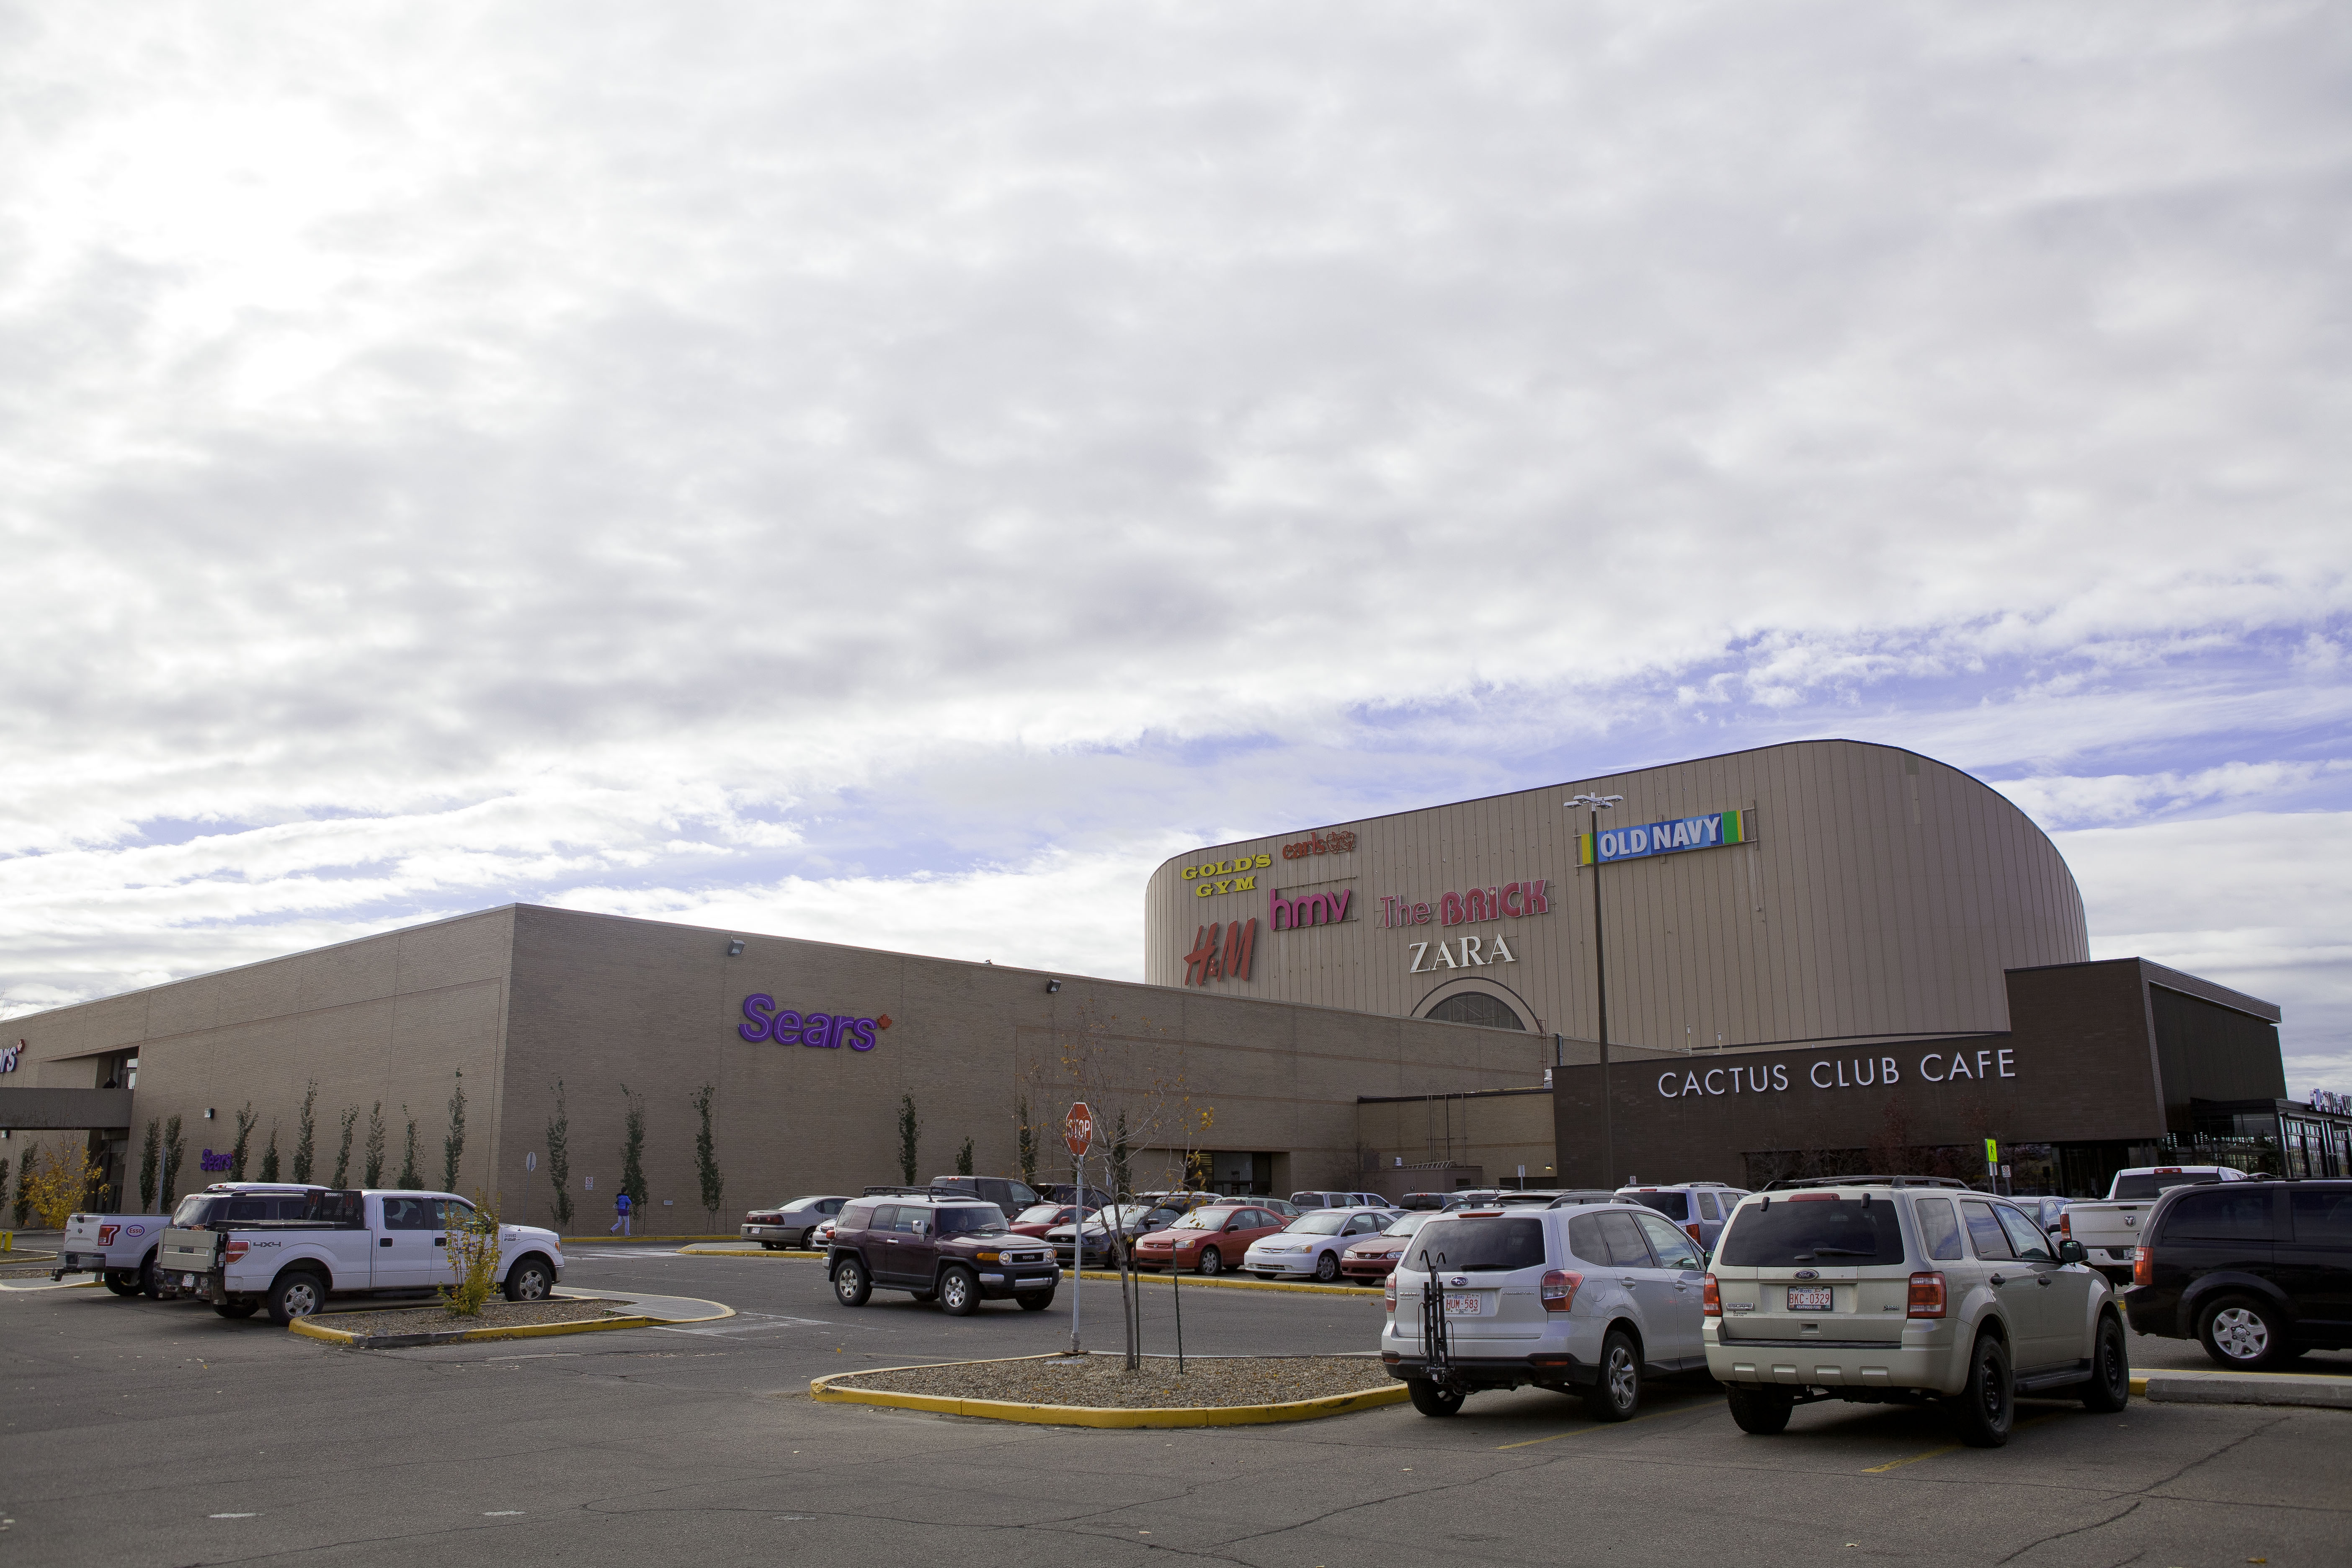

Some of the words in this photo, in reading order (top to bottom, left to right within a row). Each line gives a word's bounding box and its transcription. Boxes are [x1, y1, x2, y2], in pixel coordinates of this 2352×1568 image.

[1282, 831, 1326, 860] earls
[1600, 829, 1648, 857] OLD
[1653, 817, 1720, 850] NAVY
[1181, 853, 1271, 880] GOLD'S
[1196, 875, 1256, 897] GYM
[1270, 888, 1351, 930] hmv
[1379, 894, 1431, 928] The
[1439, 879, 1548, 926] BRICK
[1184, 917, 1256, 986] H&M
[1409, 933, 1516, 973] ZARA
[738, 993, 878, 1052] Sears
[1658, 1064, 1789, 1098] CACTUS
[1810, 1057, 1900, 1088] CLUB
[1920, 1048, 2016, 1082] CAFE
[1068, 1119, 1090, 1139] STOP
[200, 1149, 233, 1171] Sears
[1446, 1299, 1478, 1309] HUM-583
[1789, 1293, 1830, 1304] BKC-0329
